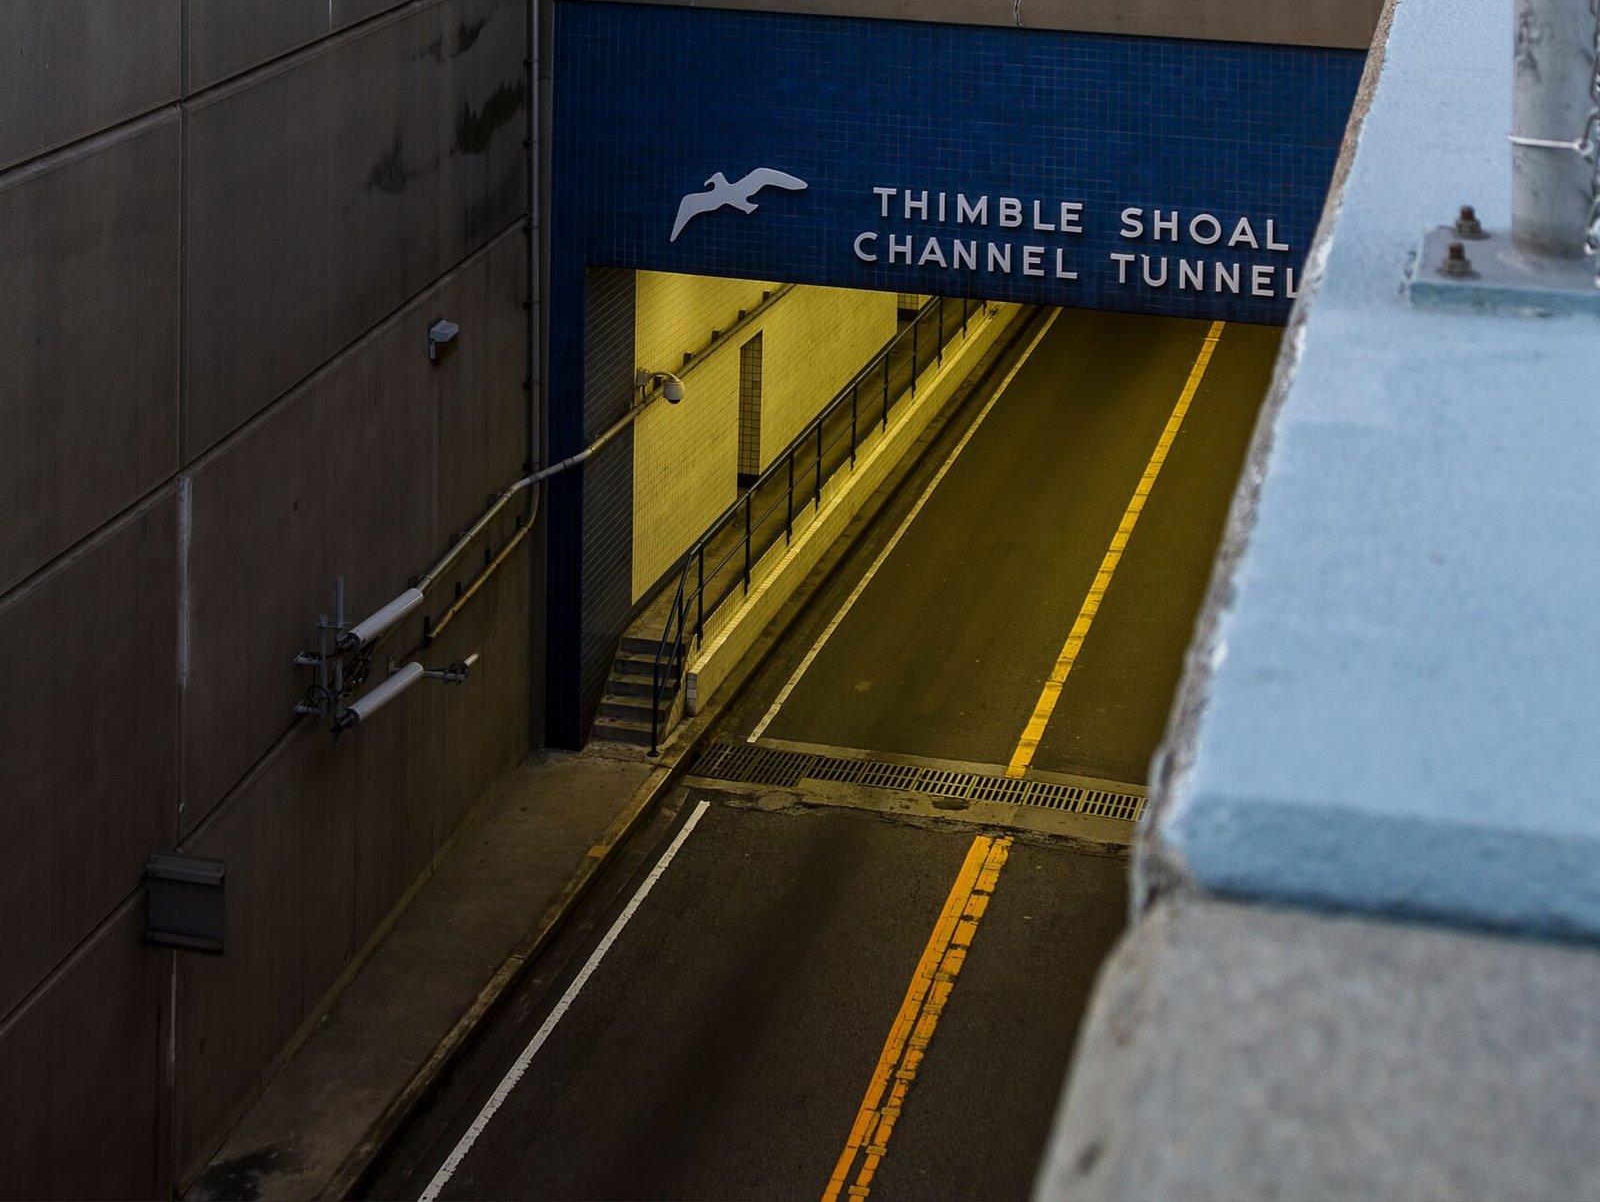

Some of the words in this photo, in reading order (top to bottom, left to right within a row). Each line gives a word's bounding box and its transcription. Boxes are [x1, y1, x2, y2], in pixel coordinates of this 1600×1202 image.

[873, 187, 1083, 234] THIMBLE
[1119, 207, 1290, 252] SHOAL
[853, 231, 1079, 280] CHANNEL
[1110, 252, 1299, 299] TUNNEL
